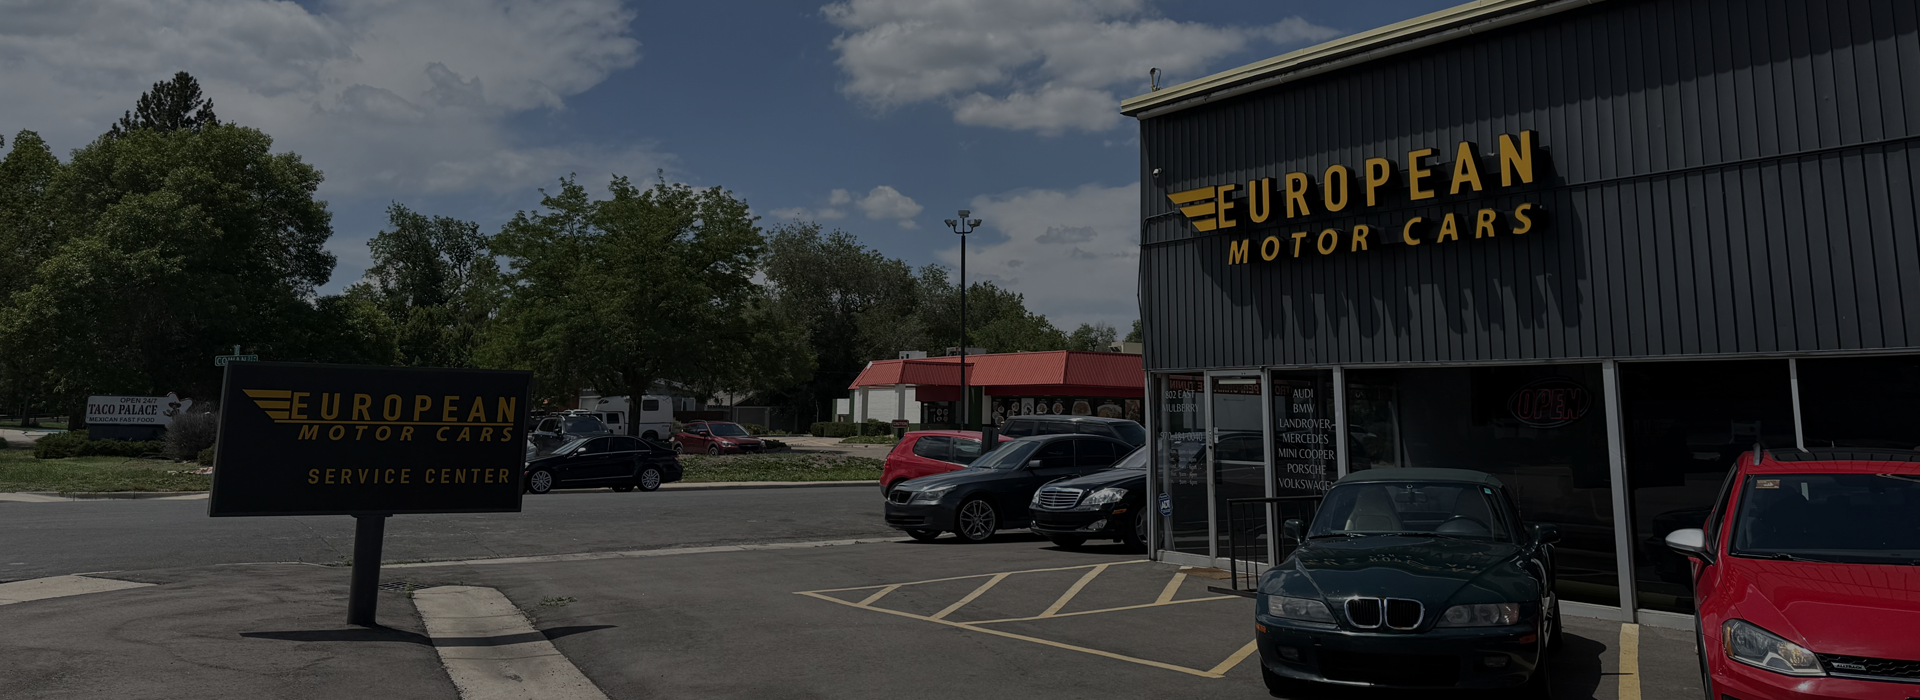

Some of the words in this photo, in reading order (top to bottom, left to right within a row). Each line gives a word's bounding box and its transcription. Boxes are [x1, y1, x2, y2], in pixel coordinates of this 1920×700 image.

[1217, 130, 1535, 229] EUROPEAN
[1228, 224, 1371, 265] MOTOR
[1403, 203, 1533, 246] CARS
[1164, 390, 1177, 399] 802
[1178, 389, 1196, 399] EAST
[1292, 388, 1314, 399] AUDI
[88, 403, 115, 415] TACO
[118, 404, 158, 416] PALACE
[290, 391, 516, 423] EUROPEAN
[1161, 403, 1200, 413] MULBERRY
[1292, 403, 1315, 413] BMW
[1518, 388, 1582, 420] OPEN
[1279, 418, 1331, 429] LANDROVER
[297, 425, 413, 441] MOTOR
[435, 426, 513, 443] CARS
[1282, 433, 1329, 445] MERCEDES
[1278, 448, 1297, 459] MINI
[1298, 448, 1335, 460] COOPER
[1287, 463, 1327, 475] PORSCHE
[307, 468, 411, 485] SERVICE
[425, 468, 510, 484] CENTER
[1278, 478, 1334, 491] VOLKSWAGE
